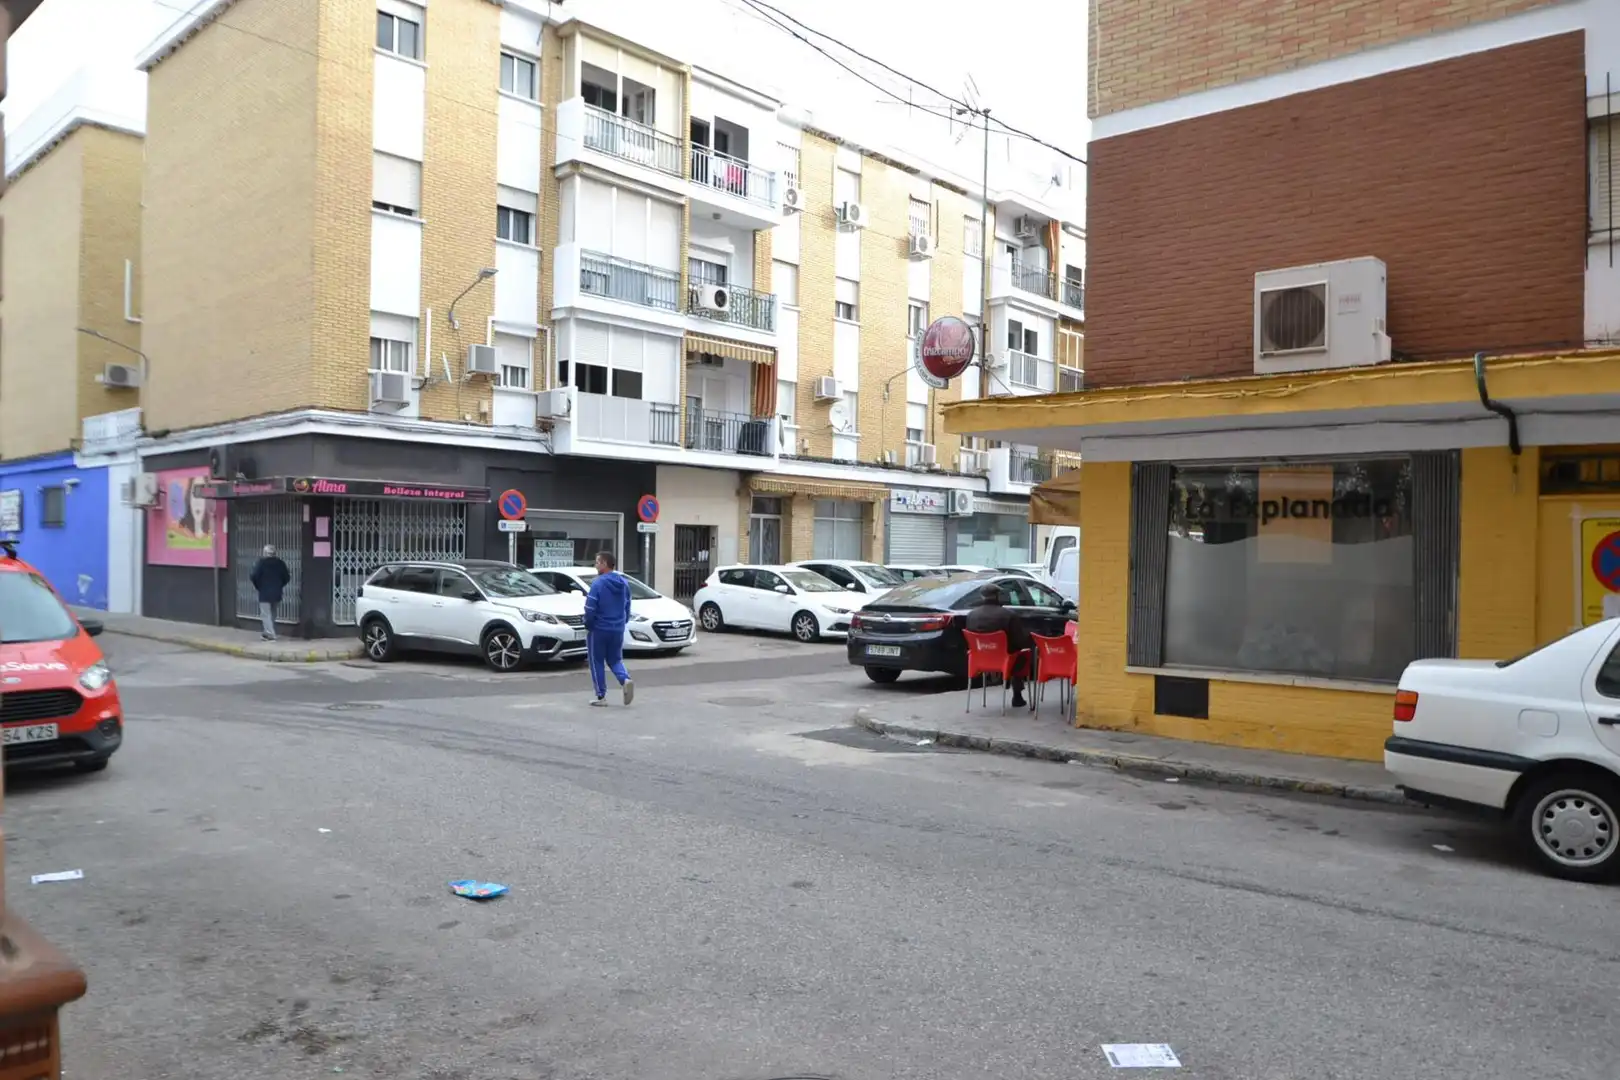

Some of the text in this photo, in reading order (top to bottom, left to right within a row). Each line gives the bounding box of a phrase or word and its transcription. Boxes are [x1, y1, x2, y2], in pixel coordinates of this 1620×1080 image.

[312, 480, 347, 493] Alma
[424, 489, 464, 498] Integral
[1184, 496, 1392, 526] La Explanada
[26, 725, 54, 739] KZS
